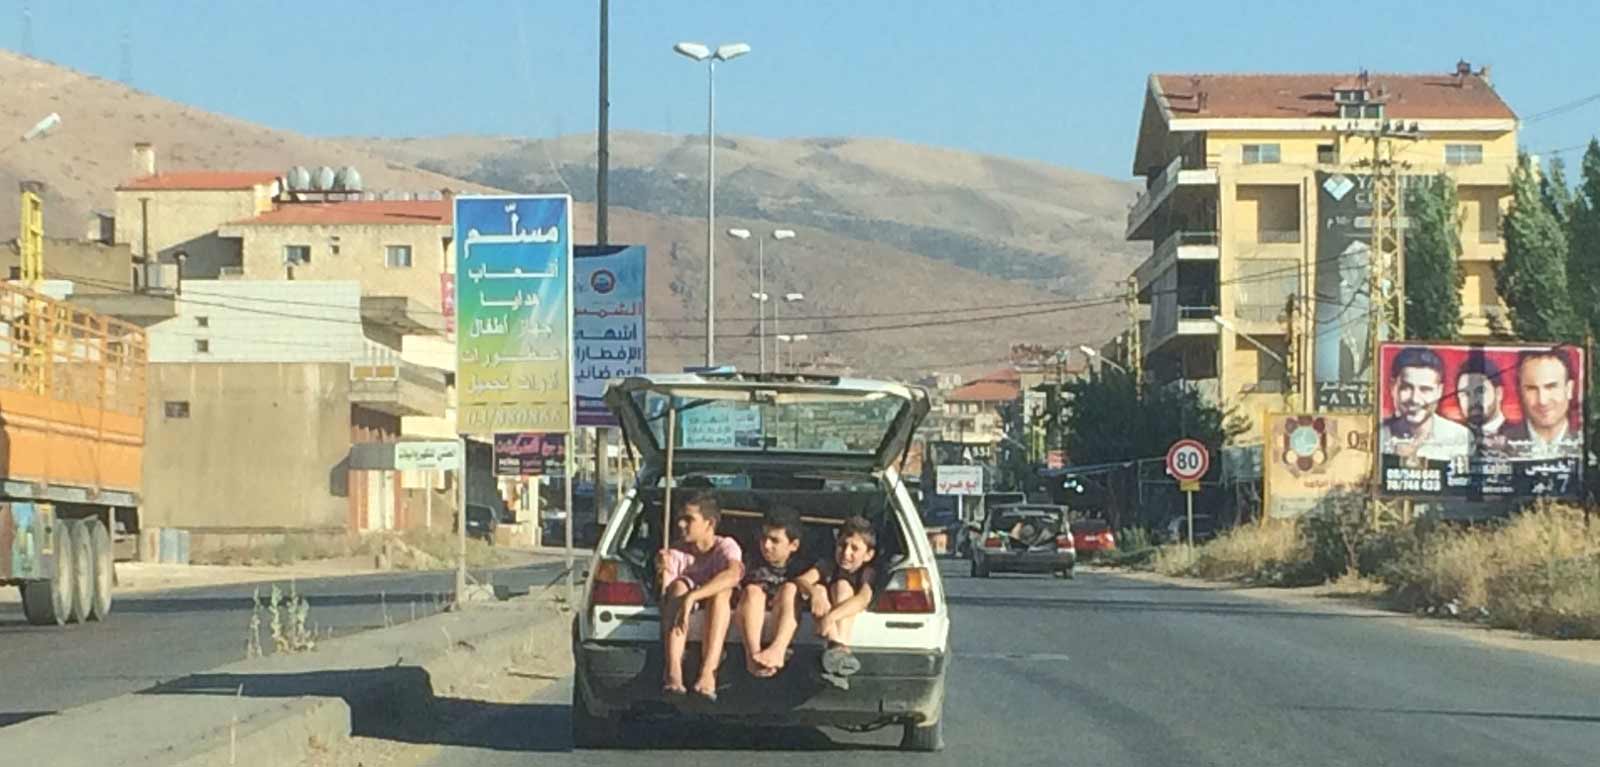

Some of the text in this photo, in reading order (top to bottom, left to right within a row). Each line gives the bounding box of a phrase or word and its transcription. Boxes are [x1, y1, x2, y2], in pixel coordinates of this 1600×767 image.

[479, 289, 540, 310] هدايا
[470, 314, 509, 338] أطفال
[1176, 452, 1198, 470] 80
